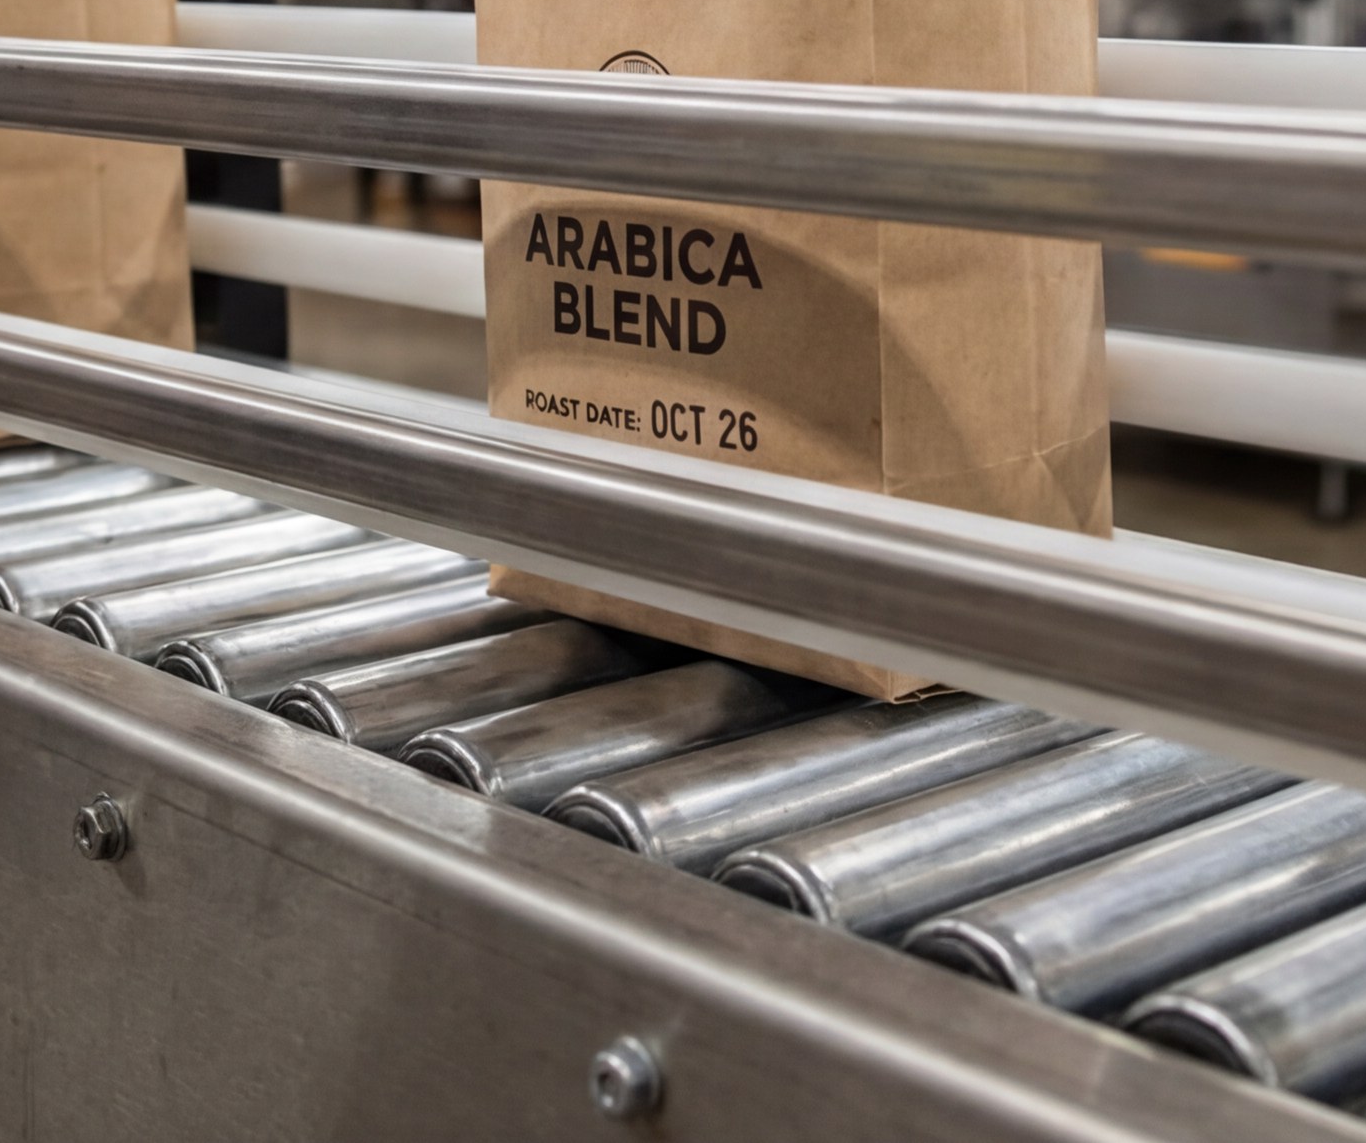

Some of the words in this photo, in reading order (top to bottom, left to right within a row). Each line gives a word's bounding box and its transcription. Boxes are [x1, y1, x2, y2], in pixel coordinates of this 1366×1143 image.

[525, 212, 763, 290] ARABICA
[553, 280, 727, 355] BLEND
[525, 388, 580, 420] ROAST
[586, 402, 642, 433] DATE:
[650, 399, 706, 446] OCT
[718, 408, 758, 452] 26
